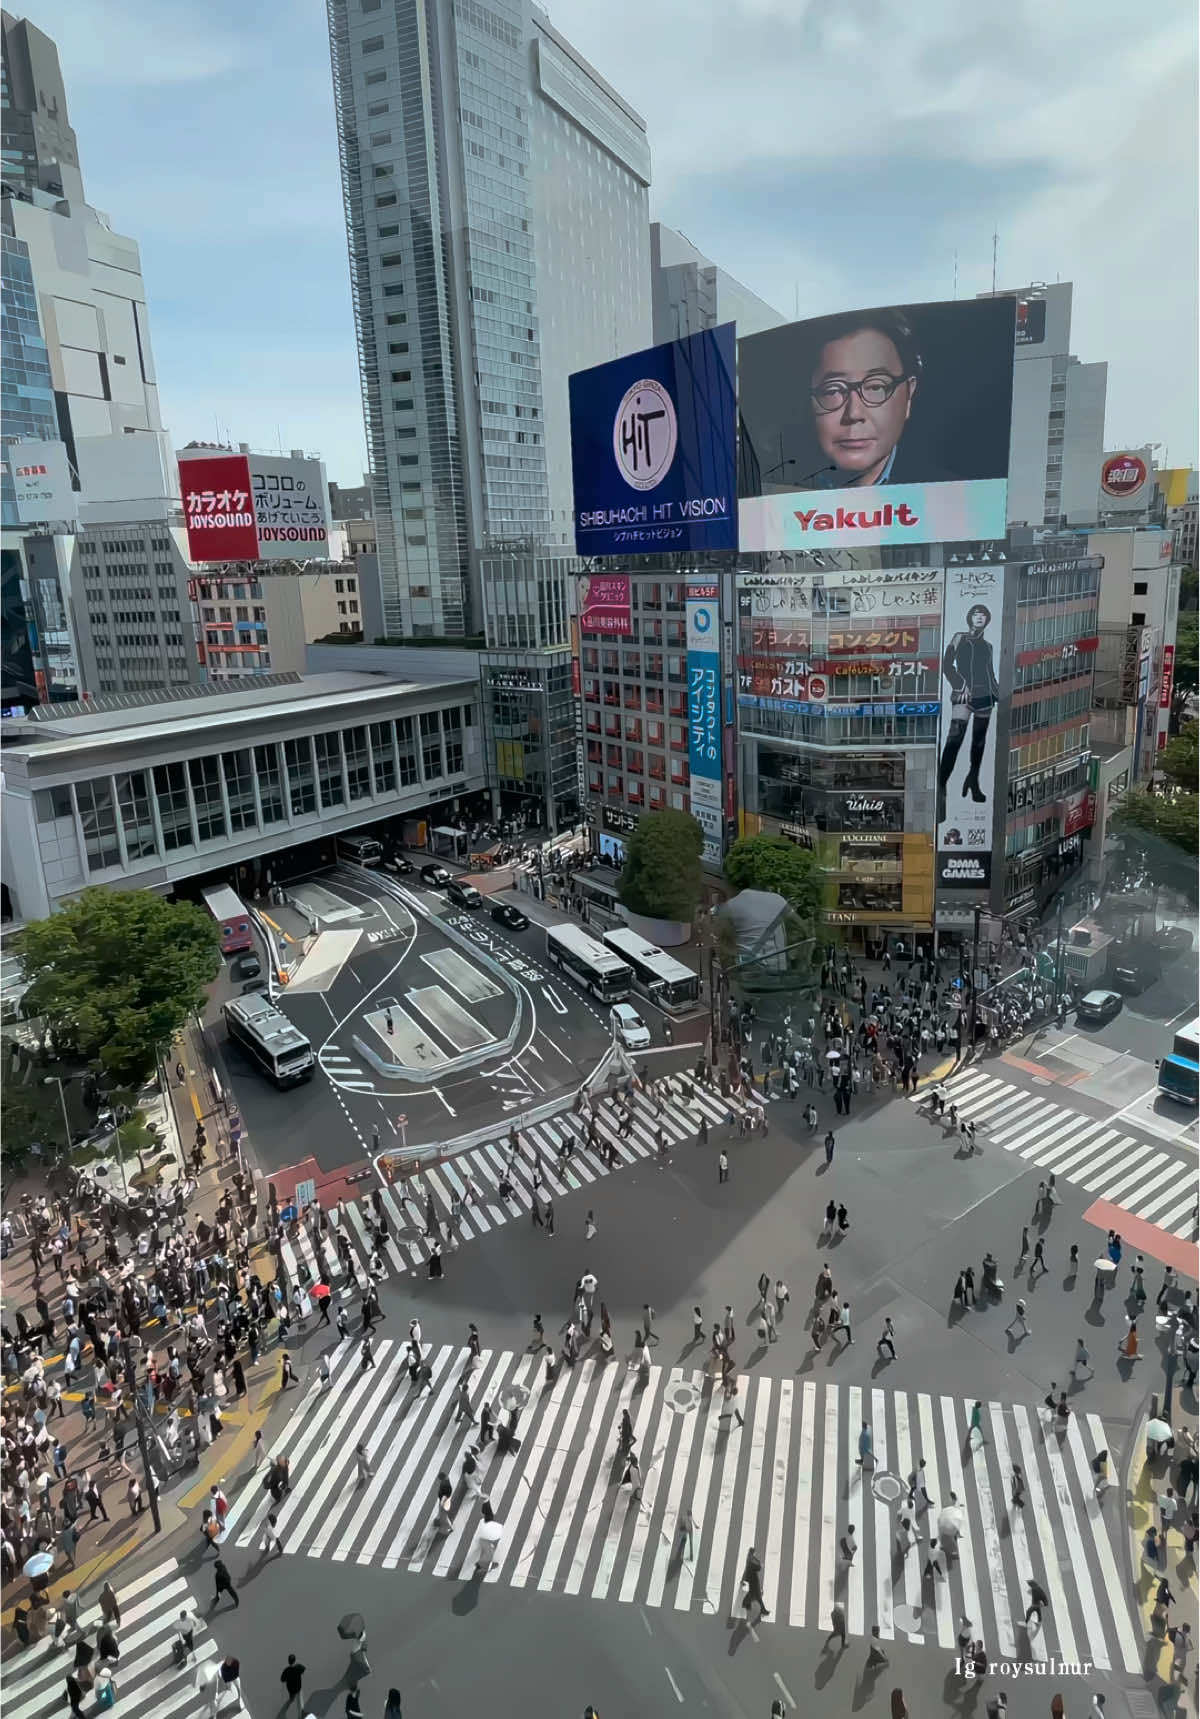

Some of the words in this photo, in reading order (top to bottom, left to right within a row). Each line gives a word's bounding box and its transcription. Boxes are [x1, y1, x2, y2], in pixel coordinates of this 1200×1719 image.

[252, 474, 306, 492] ココロの
[187, 489, 249, 513] カラオケ
[580, 505, 647, 527] SHIBUHACHI
[653, 502, 673, 520] HIT
[679, 496, 726, 517] VISION
[794, 502, 920, 532] Yakult
[189, 512, 252, 530] JOYSOUND
[258, 527, 326, 542] JOYSOUND
[842, 571, 939, 585] しゃぶしゃぶバイキング
[882, 588, 938, 607] しゃぶ葉
[829, 632, 916, 649] コンタクト
[785, 661, 814, 676] ガスト
[888, 662, 929, 676] ガスト
[740, 676, 752, 689] 7F
[771, 677, 805, 697] ガスト
[690, 668, 705, 758] アイシティ
[706, 669, 718, 760] コンタクトの
[897, 703, 939, 714] イーオン
[947, 858, 980, 869] DMM
[942, 868, 985, 879] GAMES
